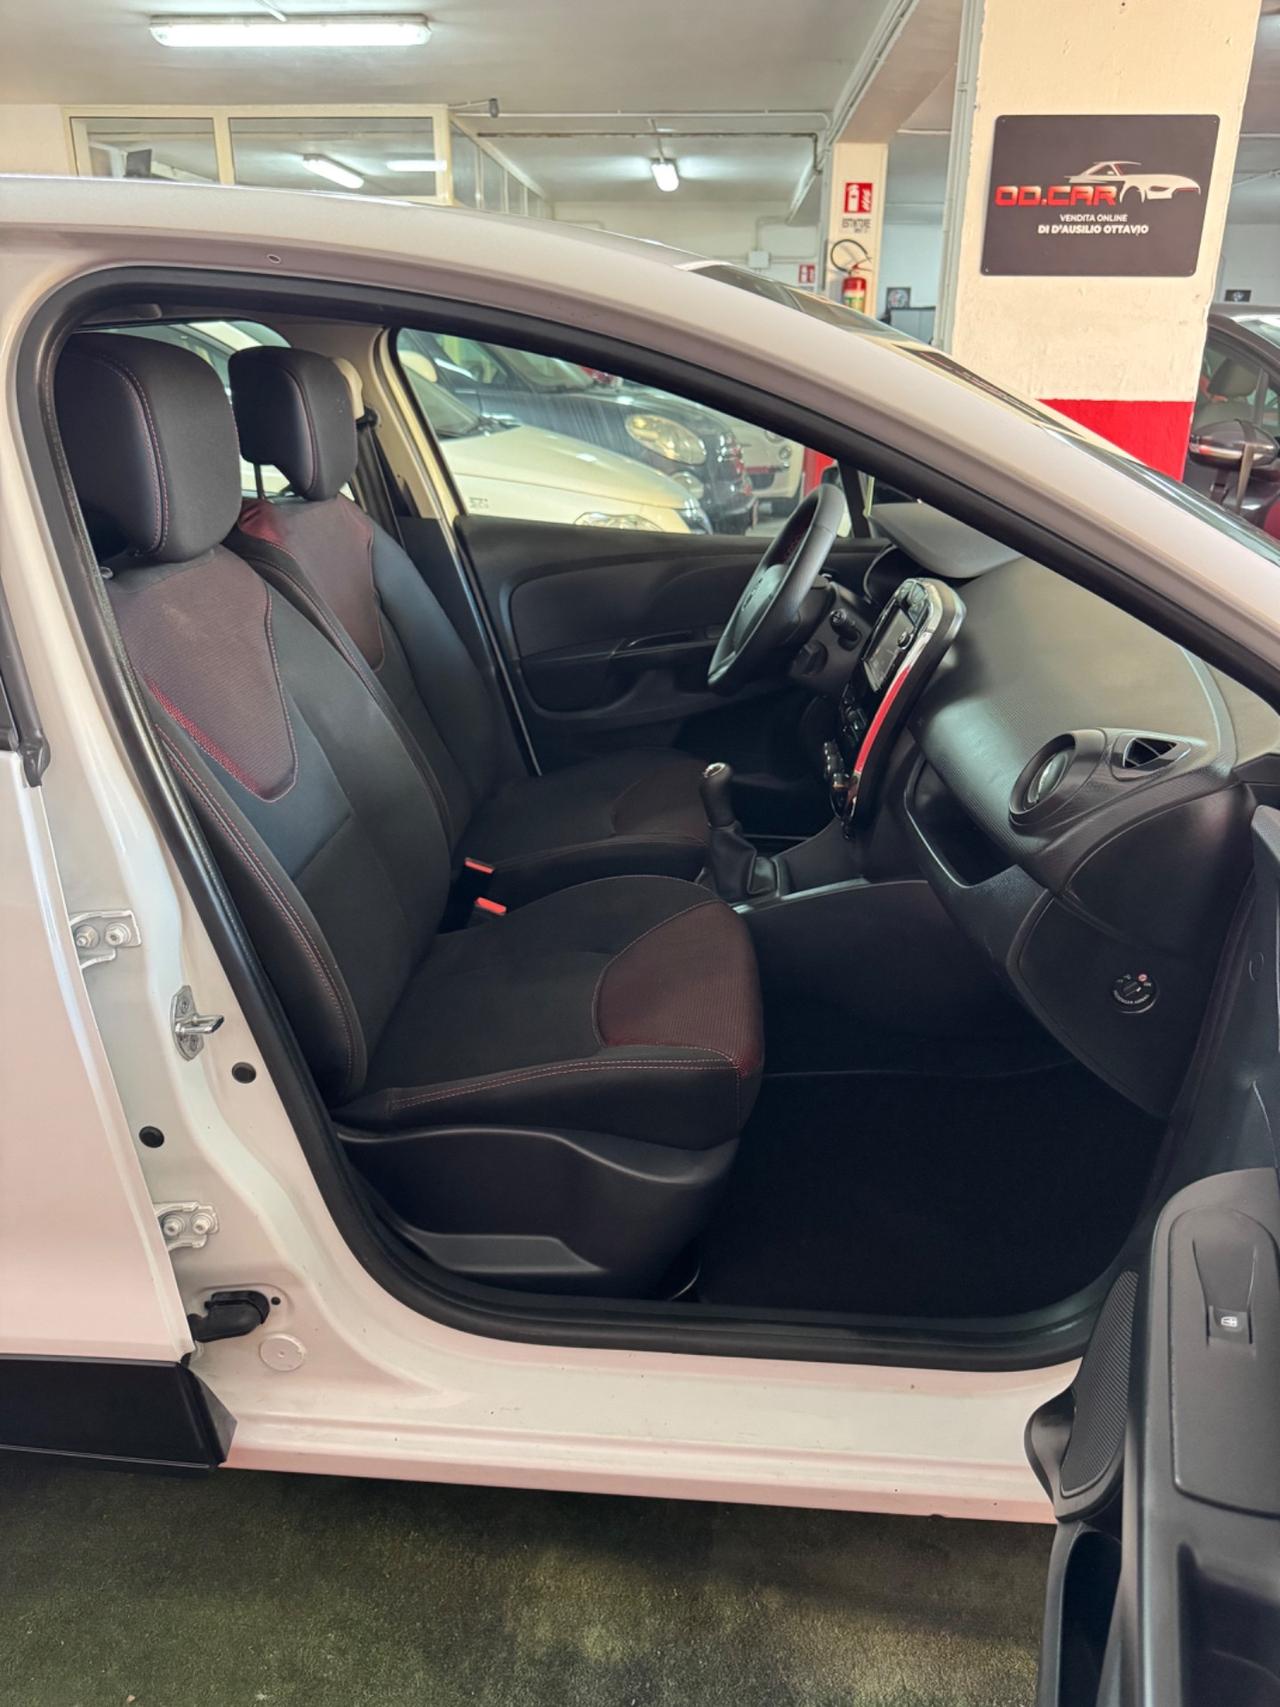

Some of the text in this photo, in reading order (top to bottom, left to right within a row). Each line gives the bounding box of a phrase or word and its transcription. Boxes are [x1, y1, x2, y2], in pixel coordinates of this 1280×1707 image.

[994, 185, 1117, 206] OD.CAR
[1060, 214, 1128, 222] VENDITA ONLINE
[1037, 224, 1149, 235] DI D'AUSILIO OTTAVIO
